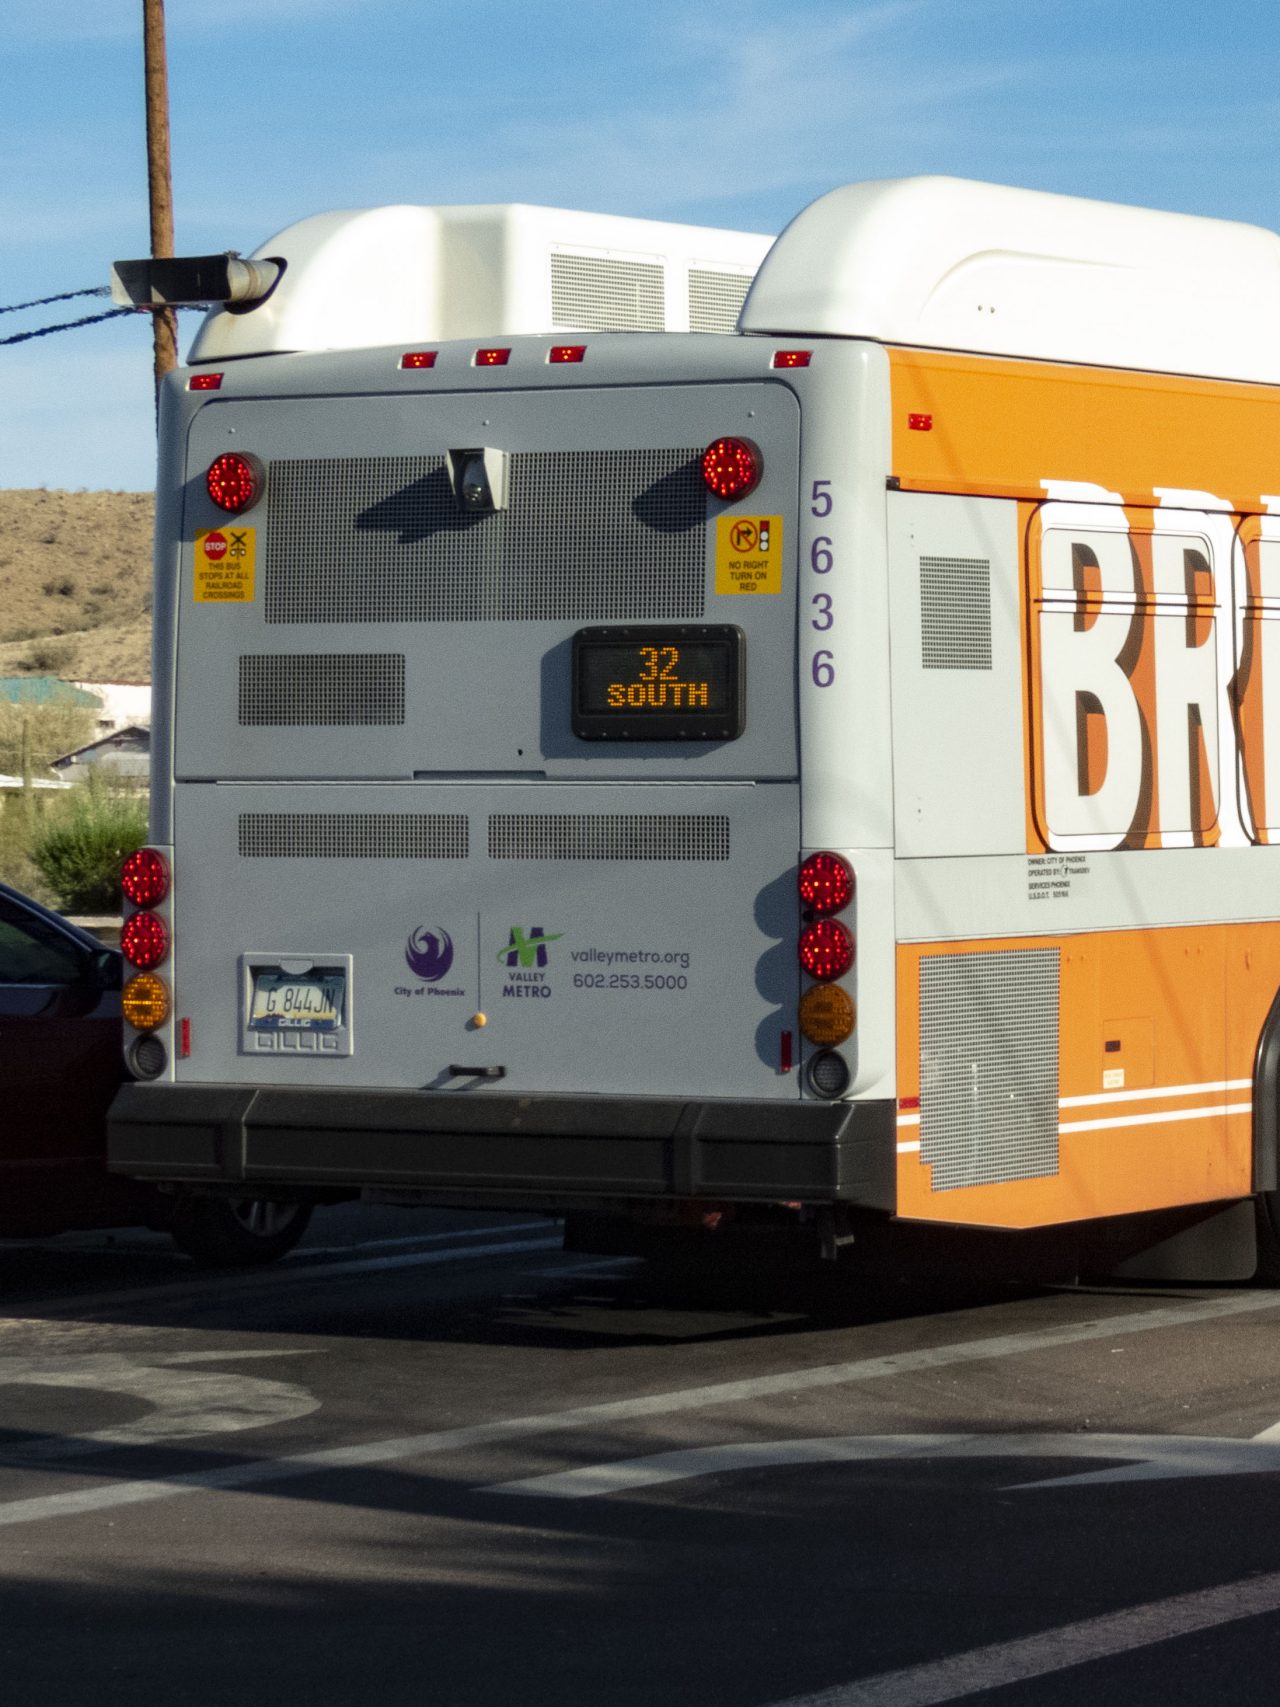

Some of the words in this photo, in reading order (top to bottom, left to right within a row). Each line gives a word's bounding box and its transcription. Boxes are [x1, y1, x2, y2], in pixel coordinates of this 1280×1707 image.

[205, 542, 227, 552] STOP
[208, 562, 225, 571] THIS
[226, 562, 241, 571] BUS
[728, 561, 741, 570] NO
[743, 560, 769, 570] RIGHT
[199, 572, 223, 580] STOPS
[730, 571, 753, 580] TURN
[754, 571, 767, 580] ON
[739, 582, 757, 591] RED
[811, 480, 835, 688] 5636
[202, 591, 245, 599] CROSSINGS
[639, 646, 679, 681] 32
[607, 683, 709, 706] SOUTH
[570, 948, 690, 968] valleymetro.org
[508, 972, 545, 982] VALLEY
[573, 973, 688, 989] 602.253.5000
[394, 986, 411, 997] City
[414, 987, 425, 996] of
[428, 987, 465, 996] Phoenix
[502, 985, 552, 998] METRO
[266, 987, 276, 1012] G
[283, 987, 336, 1013] 844JN
[254, 1031, 338, 1051] GILLIG
